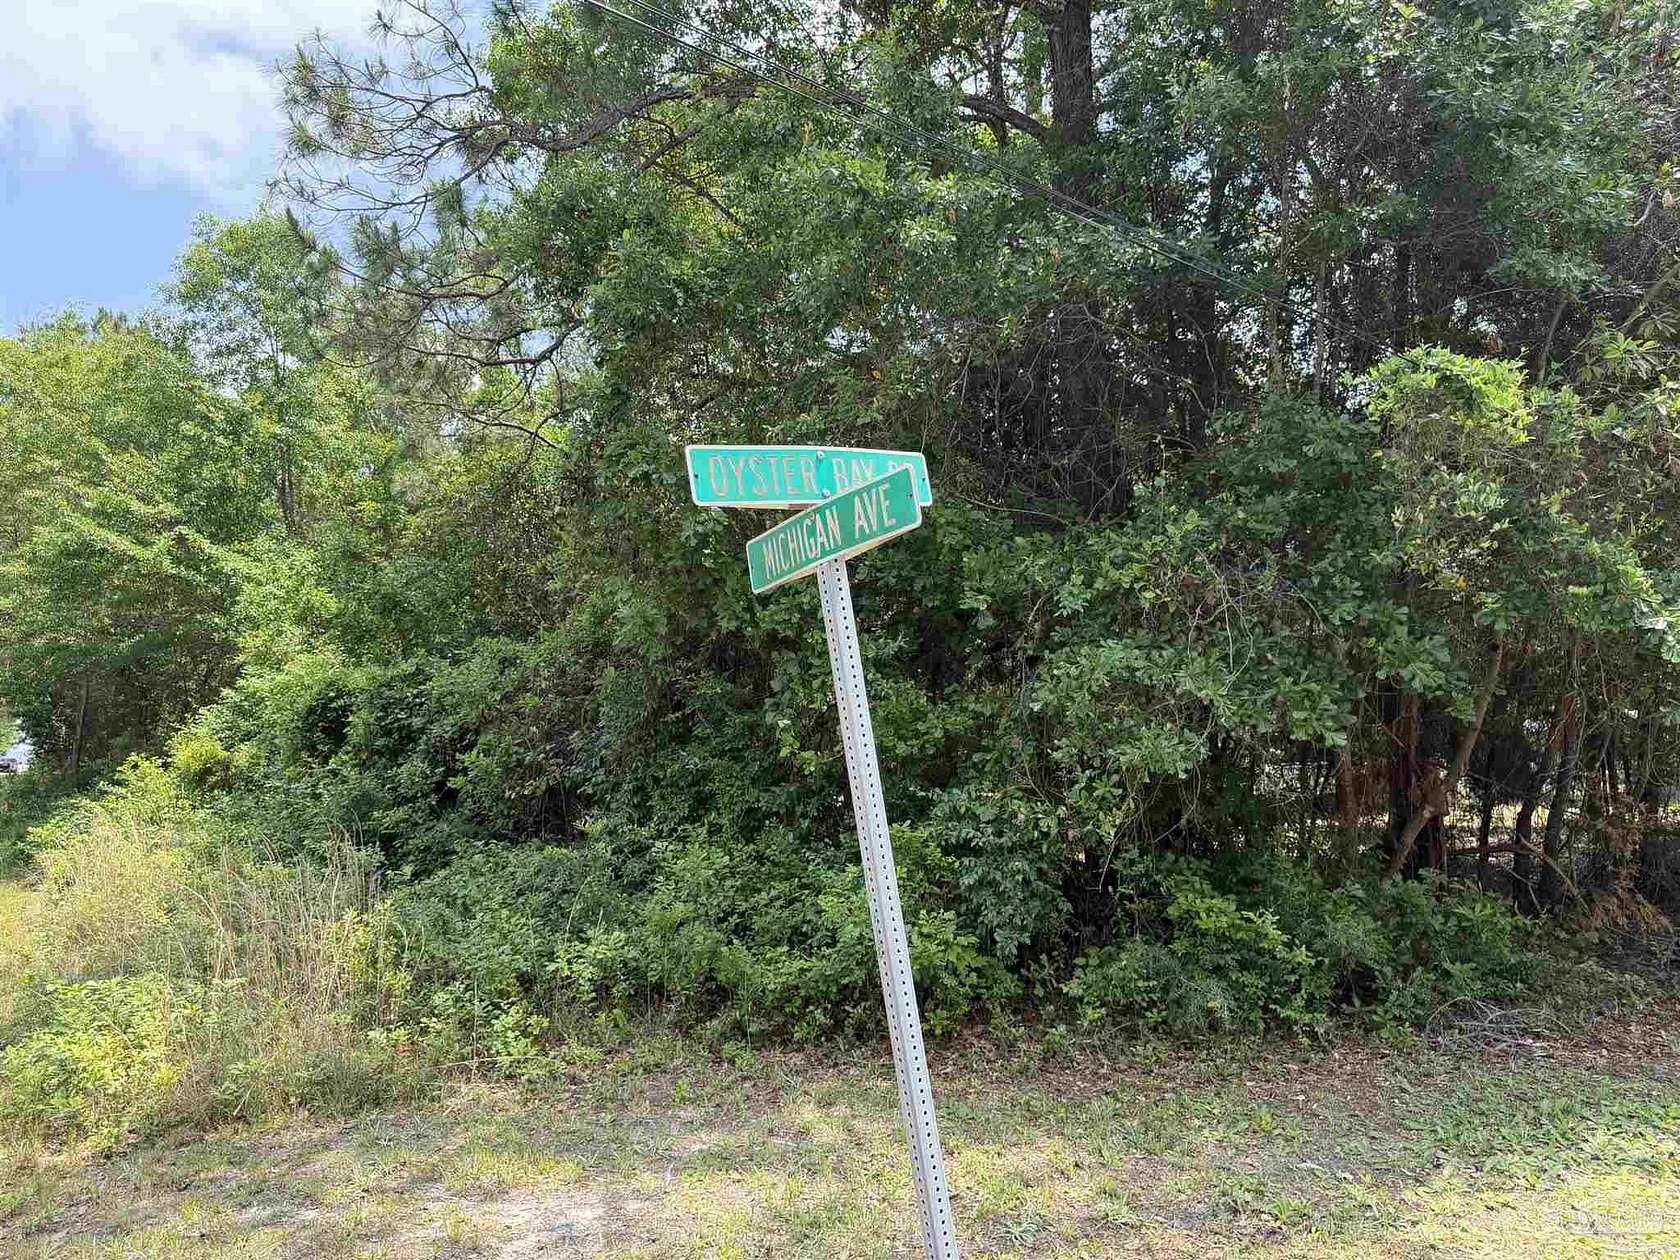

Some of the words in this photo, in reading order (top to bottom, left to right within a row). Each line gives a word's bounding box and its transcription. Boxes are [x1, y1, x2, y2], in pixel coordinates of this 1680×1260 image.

[709, 455, 817, 498] OYSTER
[833, 456, 874, 494] BAY
[763, 506, 842, 580] MICHIGAN
[854, 483, 896, 538] AVE
